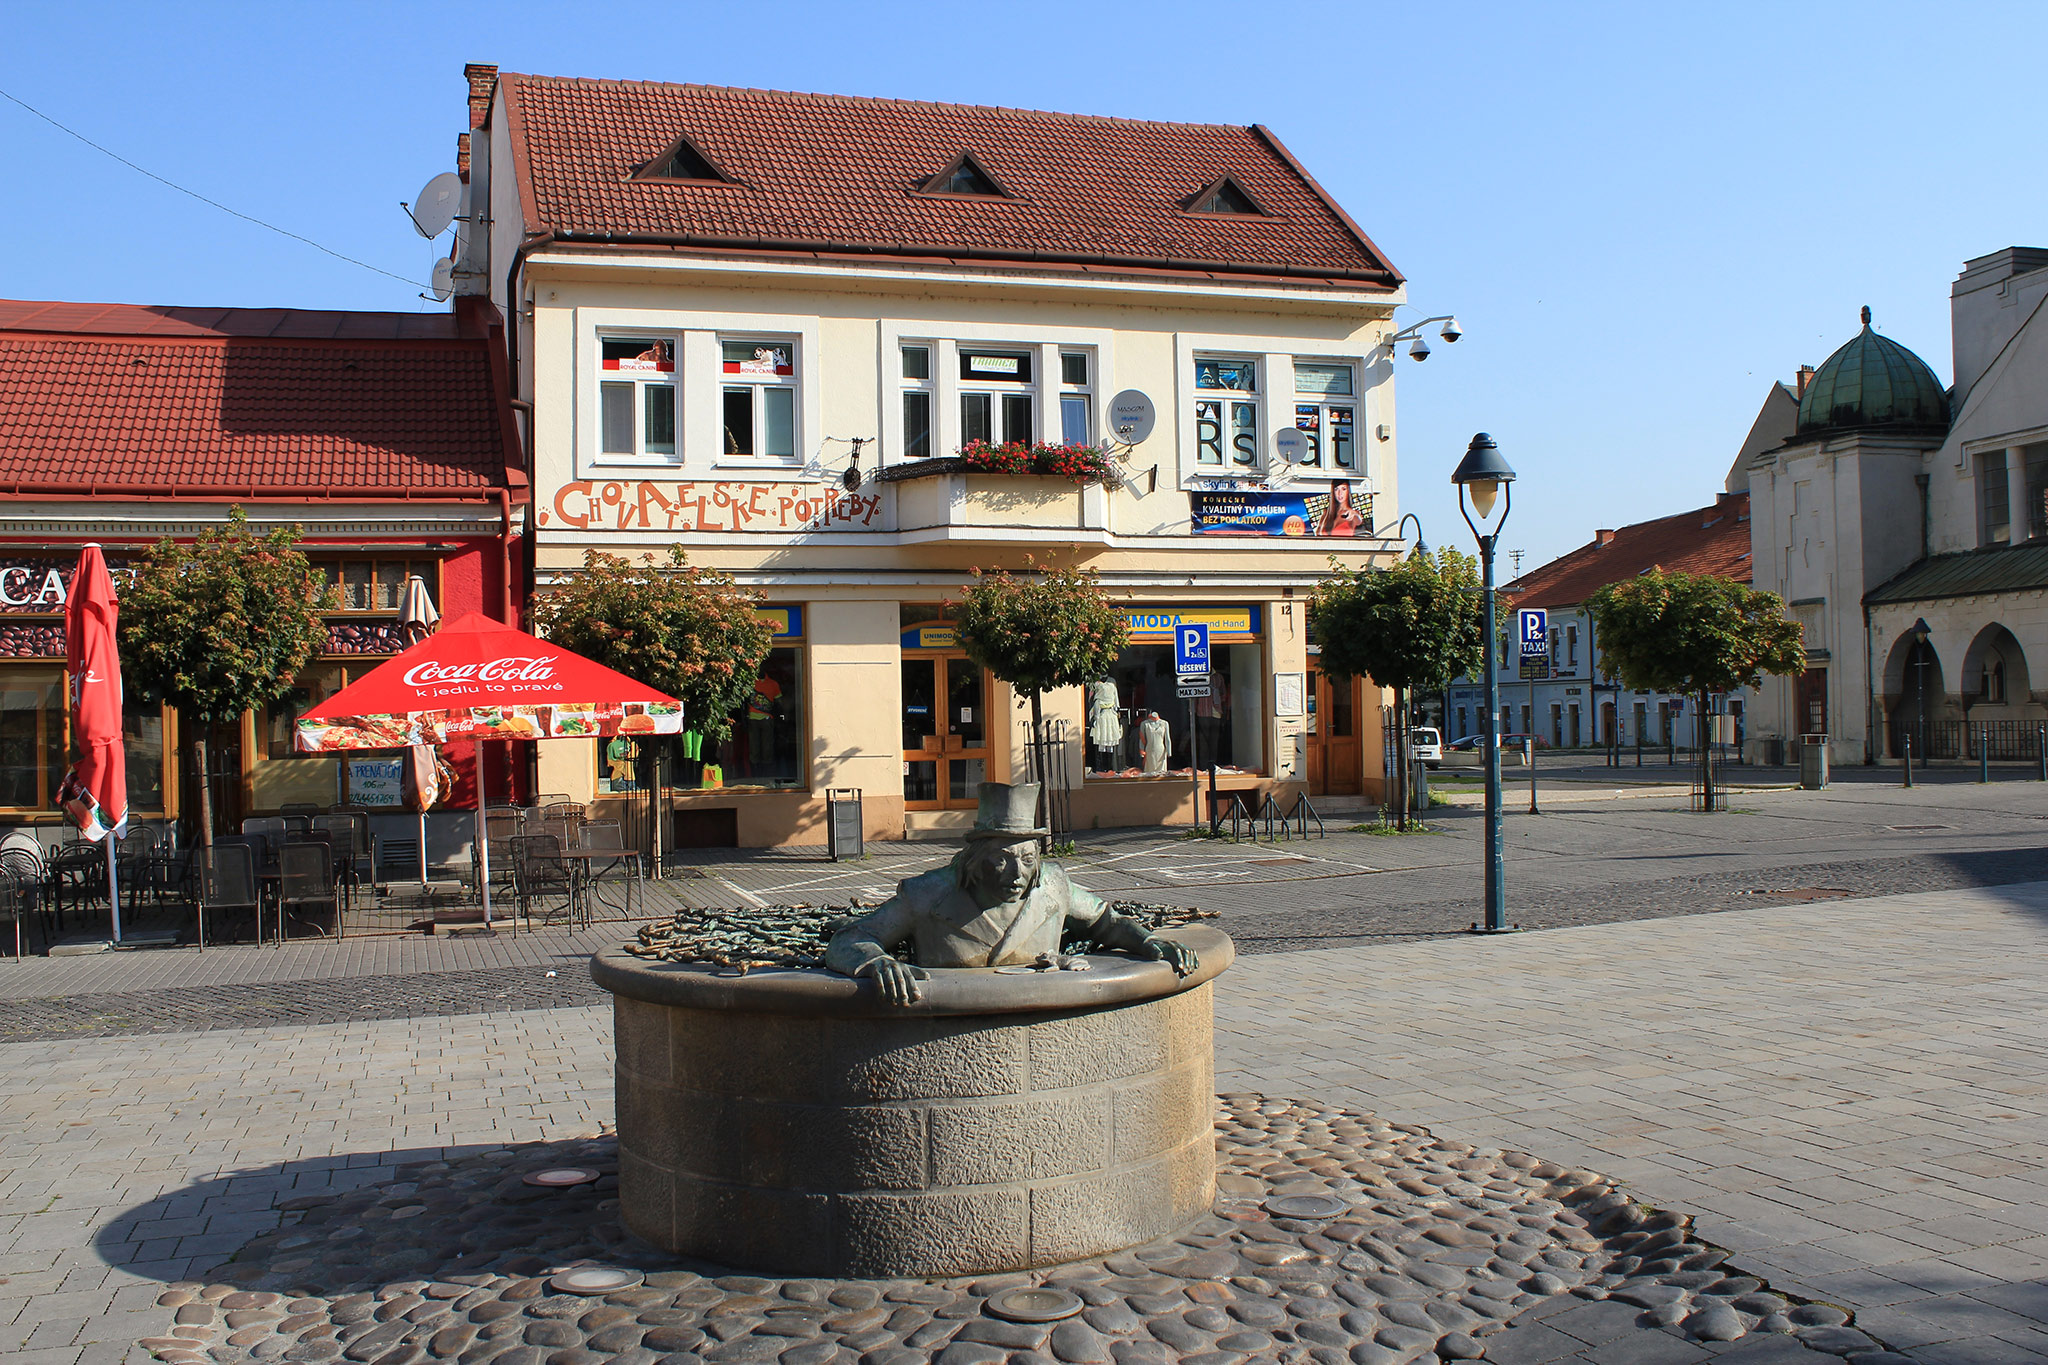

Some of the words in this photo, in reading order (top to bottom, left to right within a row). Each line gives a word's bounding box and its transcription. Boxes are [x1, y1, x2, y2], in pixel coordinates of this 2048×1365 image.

[1203, 480, 1237, 490] skylink
[778, 487, 881, 527] POTREBY
[1202, 504, 1243, 514] KVALITNÝ
[1244, 506, 1255, 514] TV
[1257, 504, 1286, 514] PRÍJEM
[1203, 515, 1218, 524] BEZ
[1220, 516, 1267, 525] POPLATKOV
[1281, 605, 1291, 615] 12
[1223, 619, 1245, 628] Hand
[1527, 613, 1541, 640] P
[1532, 630, 1544, 640] 2x
[1184, 629, 1201, 657] P
[1522, 642, 1546, 652] TAXI
[403, 656, 559, 687] Coca-Cola
[1179, 662, 1207, 672] RÉSERVÉ
[416, 688, 428, 697] k
[433, 685, 480, 697] jedlu
[485, 683, 506, 691] to
[512, 682, 564, 692] pravé
[363, 781, 376, 789] 106
